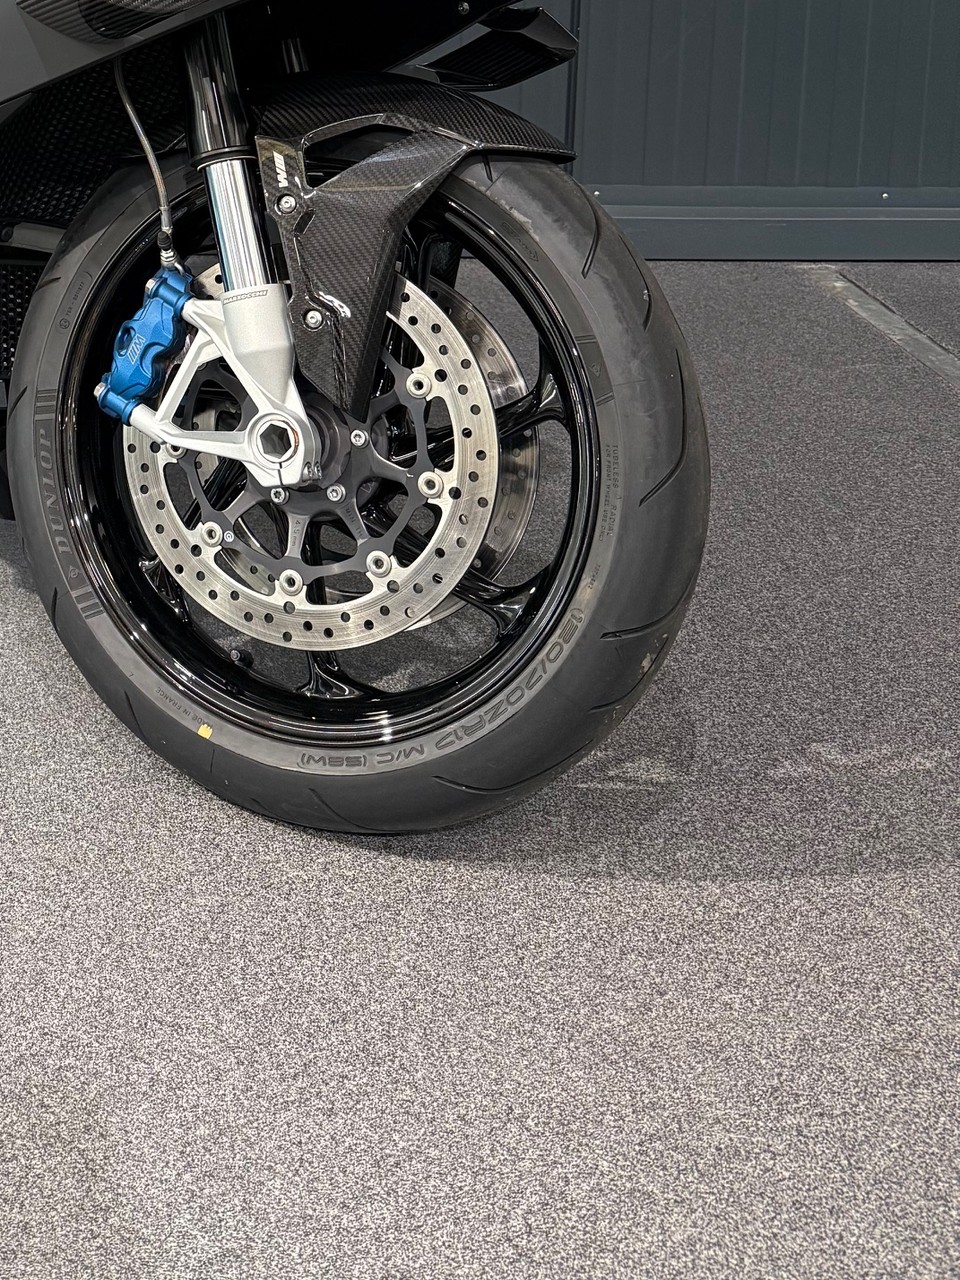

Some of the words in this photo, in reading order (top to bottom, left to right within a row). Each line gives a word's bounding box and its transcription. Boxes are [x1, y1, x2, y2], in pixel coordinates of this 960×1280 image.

[39, 428, 72, 554] DUNLOP
[434, 613, 584, 751] 120/70ZR17
[155, 686, 182, 711] FRANCE
[300, 752, 369, 768] (58W)
[376, 743, 426, 764] M/C
